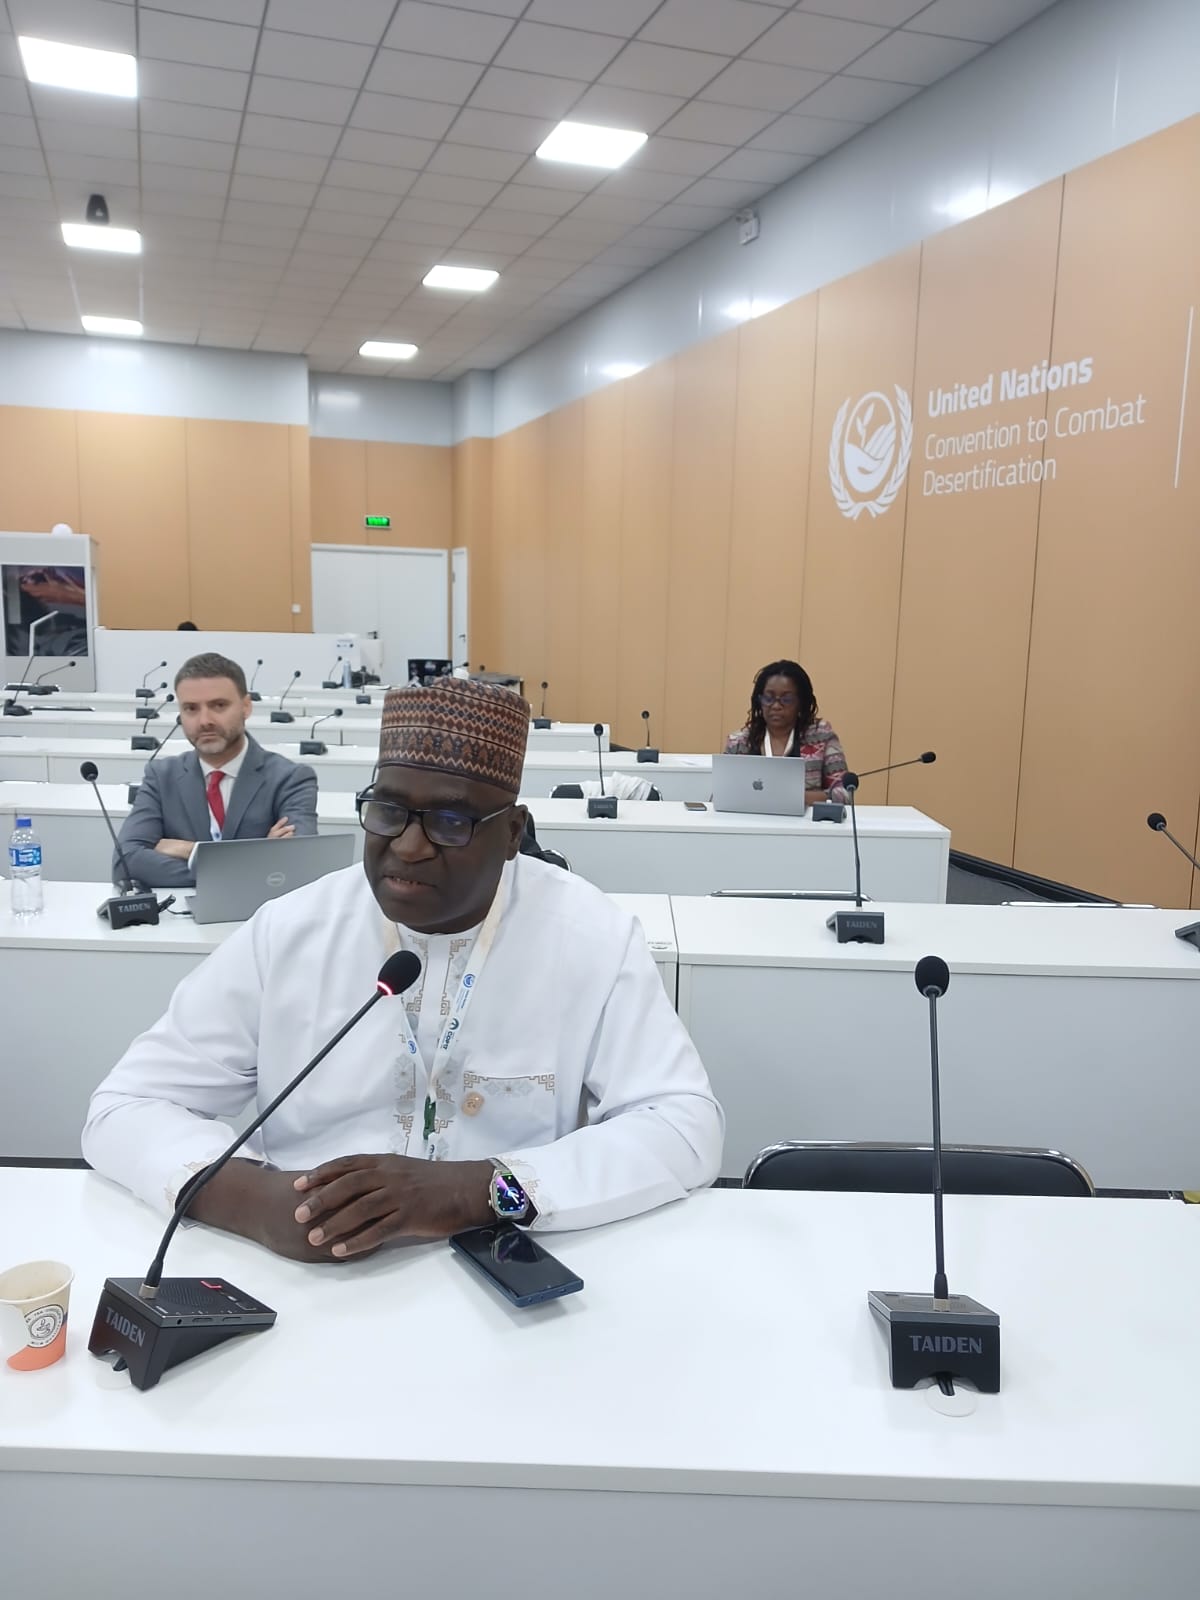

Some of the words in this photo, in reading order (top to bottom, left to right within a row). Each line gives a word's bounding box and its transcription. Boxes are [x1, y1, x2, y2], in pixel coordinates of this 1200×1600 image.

[928, 374, 993, 418] United
[999, 357, 1094, 401] Nations
[925, 422, 1021, 460] Convention
[1027, 416, 1048, 443] to
[1055, 393, 1147, 438] Combat
[923, 454, 1057, 496] Desertification
[104, 1306, 147, 1348] TAIDEN
[909, 1335, 983, 1354] TAIDEN
